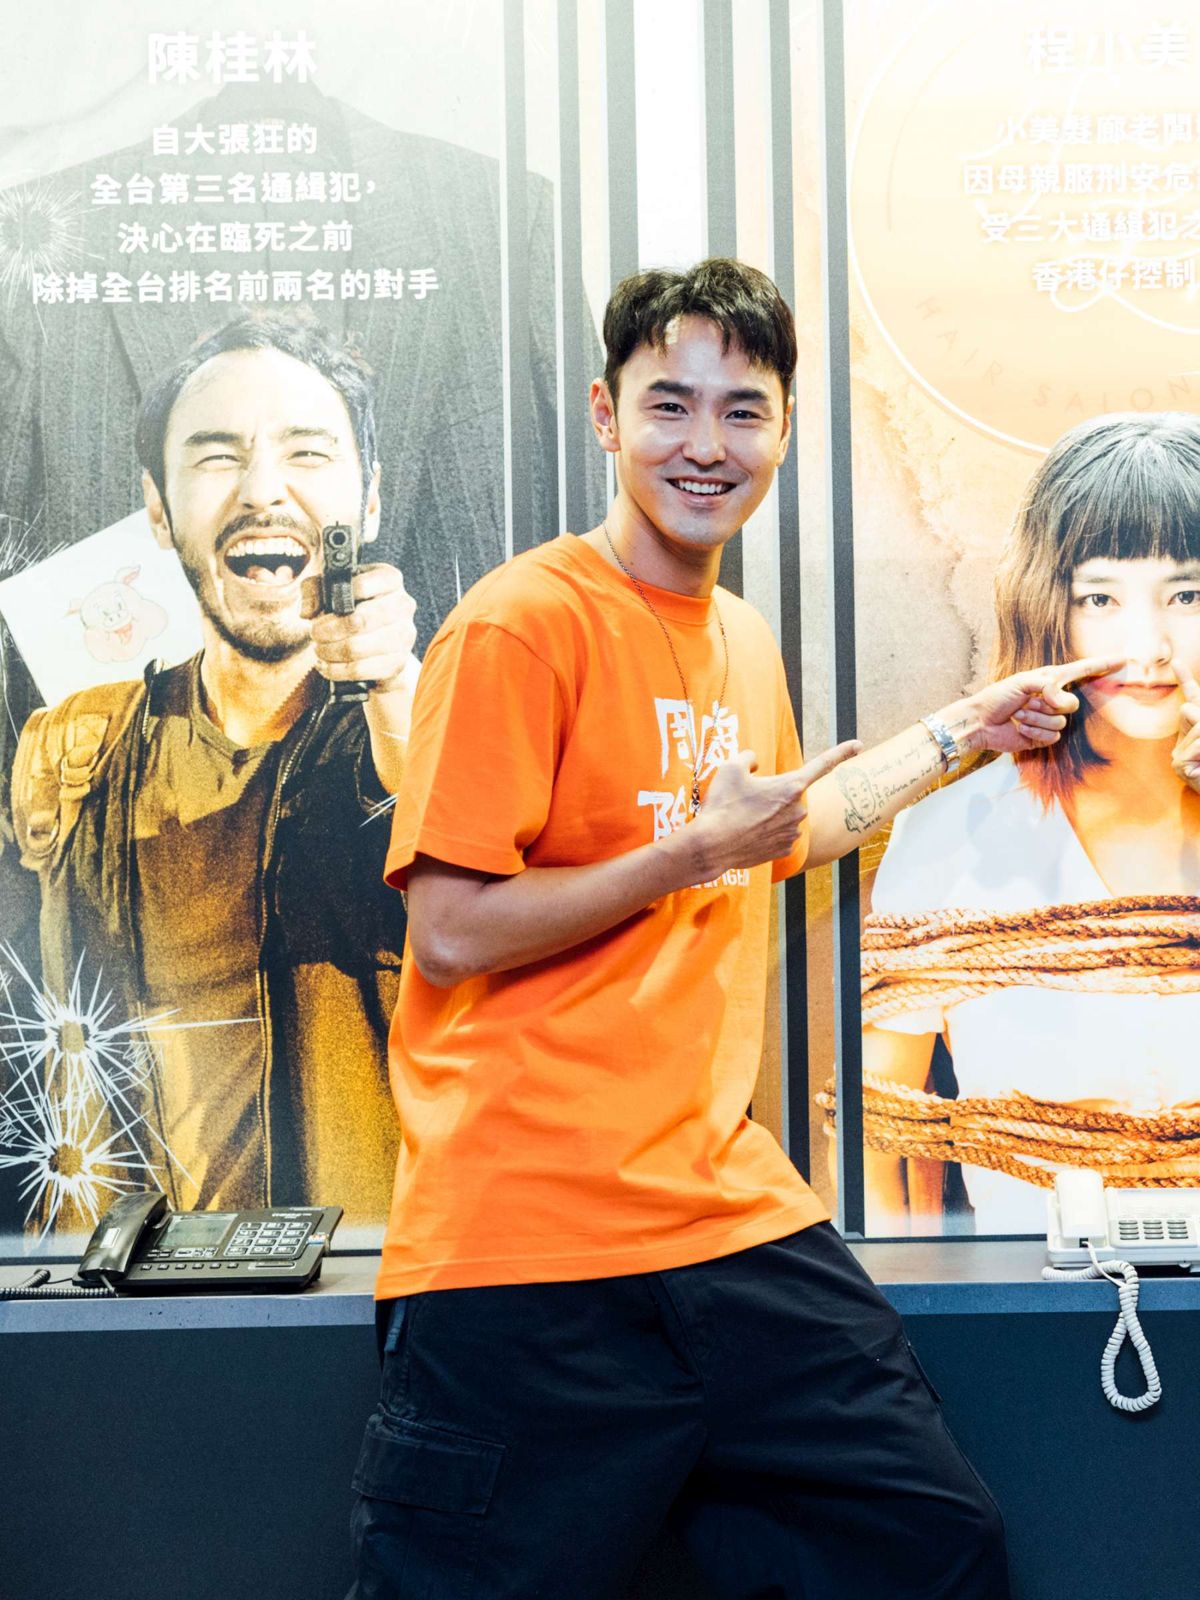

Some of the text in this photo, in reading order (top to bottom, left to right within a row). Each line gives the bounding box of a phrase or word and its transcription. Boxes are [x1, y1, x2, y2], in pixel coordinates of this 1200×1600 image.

[147, 30, 318, 84] 陳桂林
[1026, 20, 1192, 75] 程小美
[152, 123, 318, 156] 自大張狂的
[117, 221, 354, 253] 決心在臨死之前
[32, 268, 440, 304] 除掉全台排名前兩名的對手
[1031, 259, 1196, 291] 香港仔控制
[914, 294, 1192, 414] HAIR SALON
